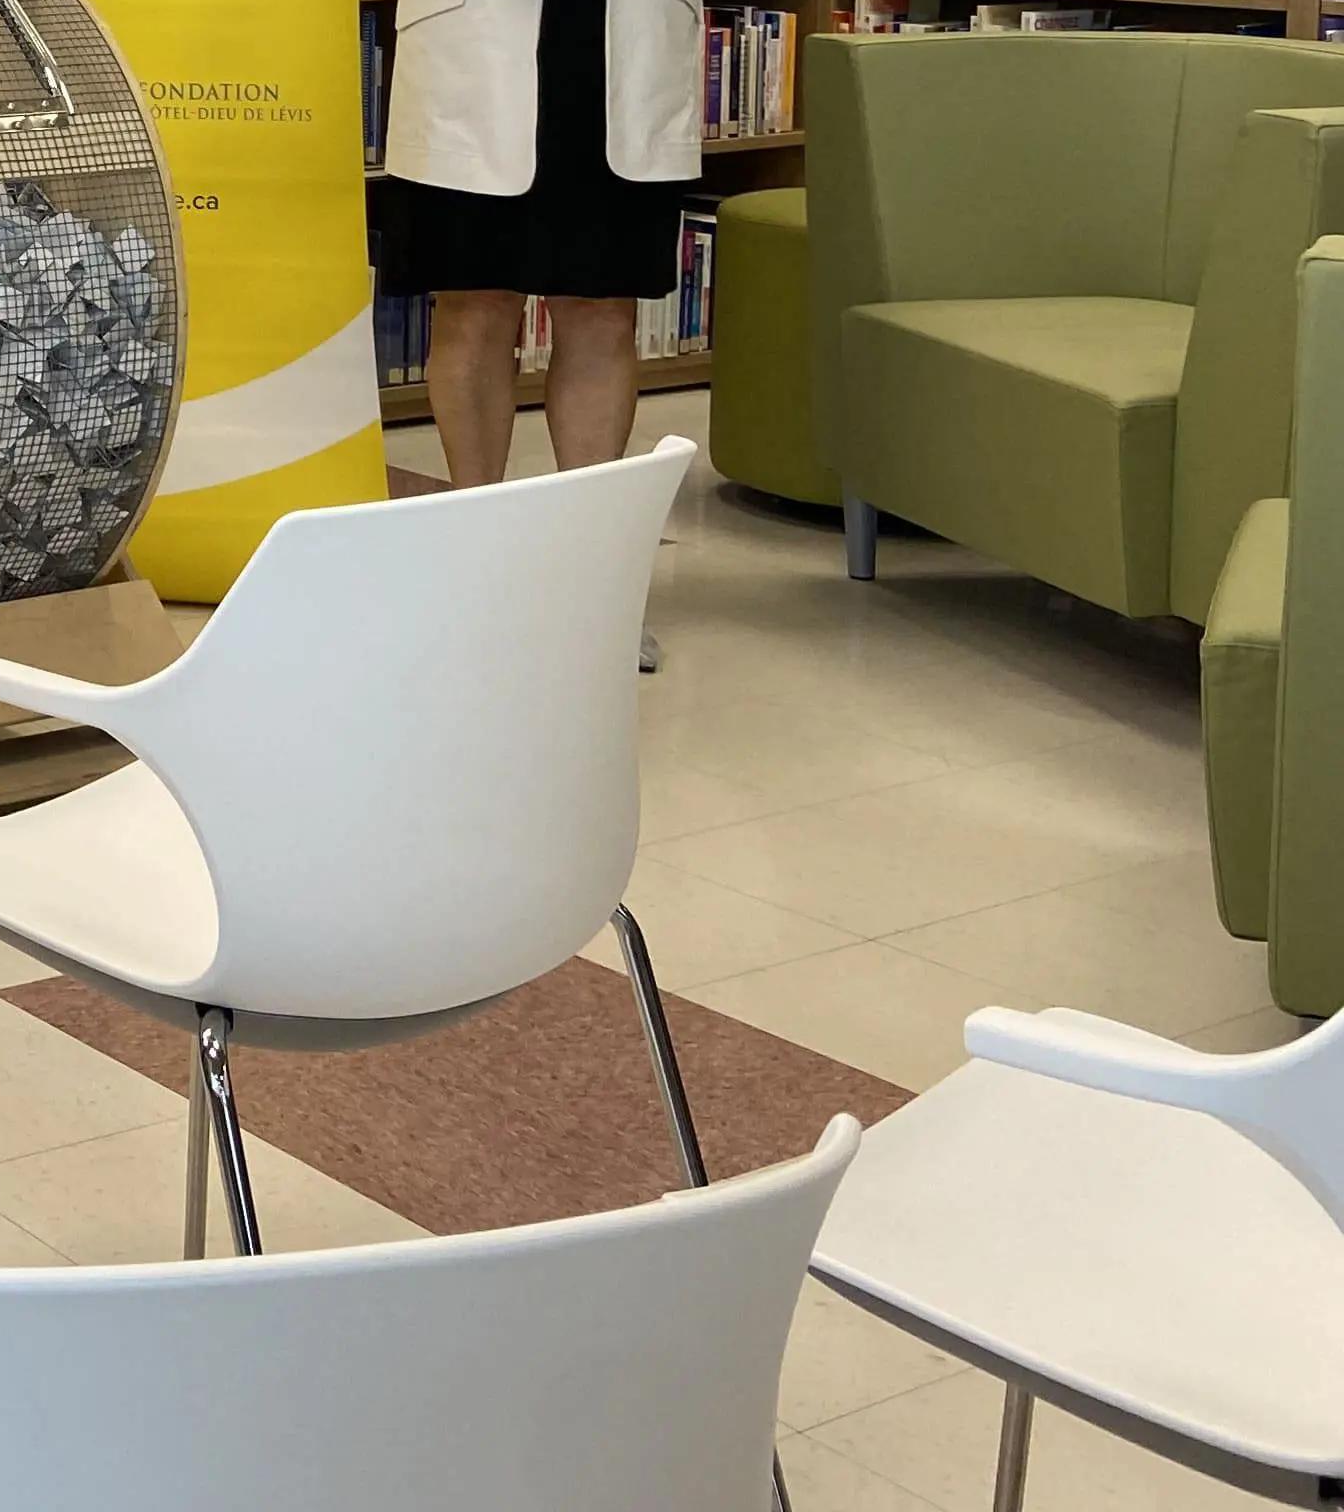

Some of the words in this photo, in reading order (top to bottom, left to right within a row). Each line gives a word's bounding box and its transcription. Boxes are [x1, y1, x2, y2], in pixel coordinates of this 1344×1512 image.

[139, 82, 279, 101] FONDATION
[150, 104, 236, 120] ÔTEL-DIEU
[243, 107, 264, 121] DE
[270, 105, 312, 122] LÉVIS
